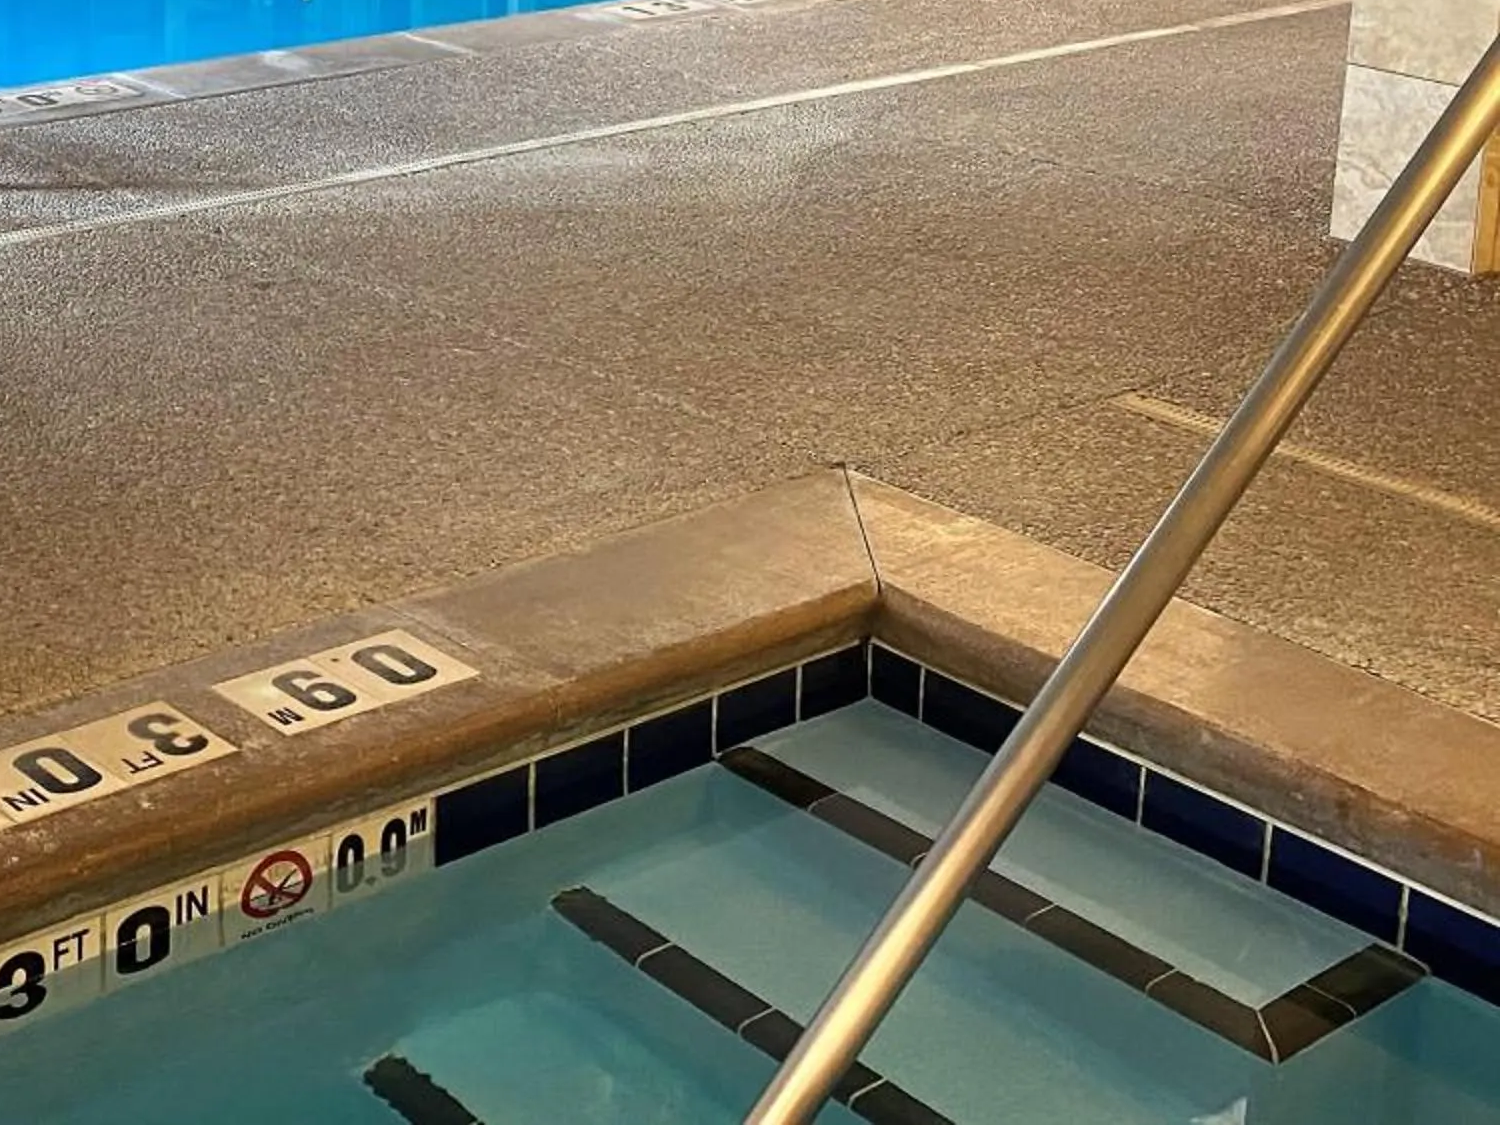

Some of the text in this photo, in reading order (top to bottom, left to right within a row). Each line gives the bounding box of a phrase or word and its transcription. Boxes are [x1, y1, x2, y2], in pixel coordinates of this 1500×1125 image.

[267, 706, 305, 726] M
[1, 713, 209, 812] 3 FT 0 IN
[410, 808, 427, 836] M
[53, 929, 91, 971] FT
[116, 906, 171, 974] 0
[176, 886, 209, 926] IN
